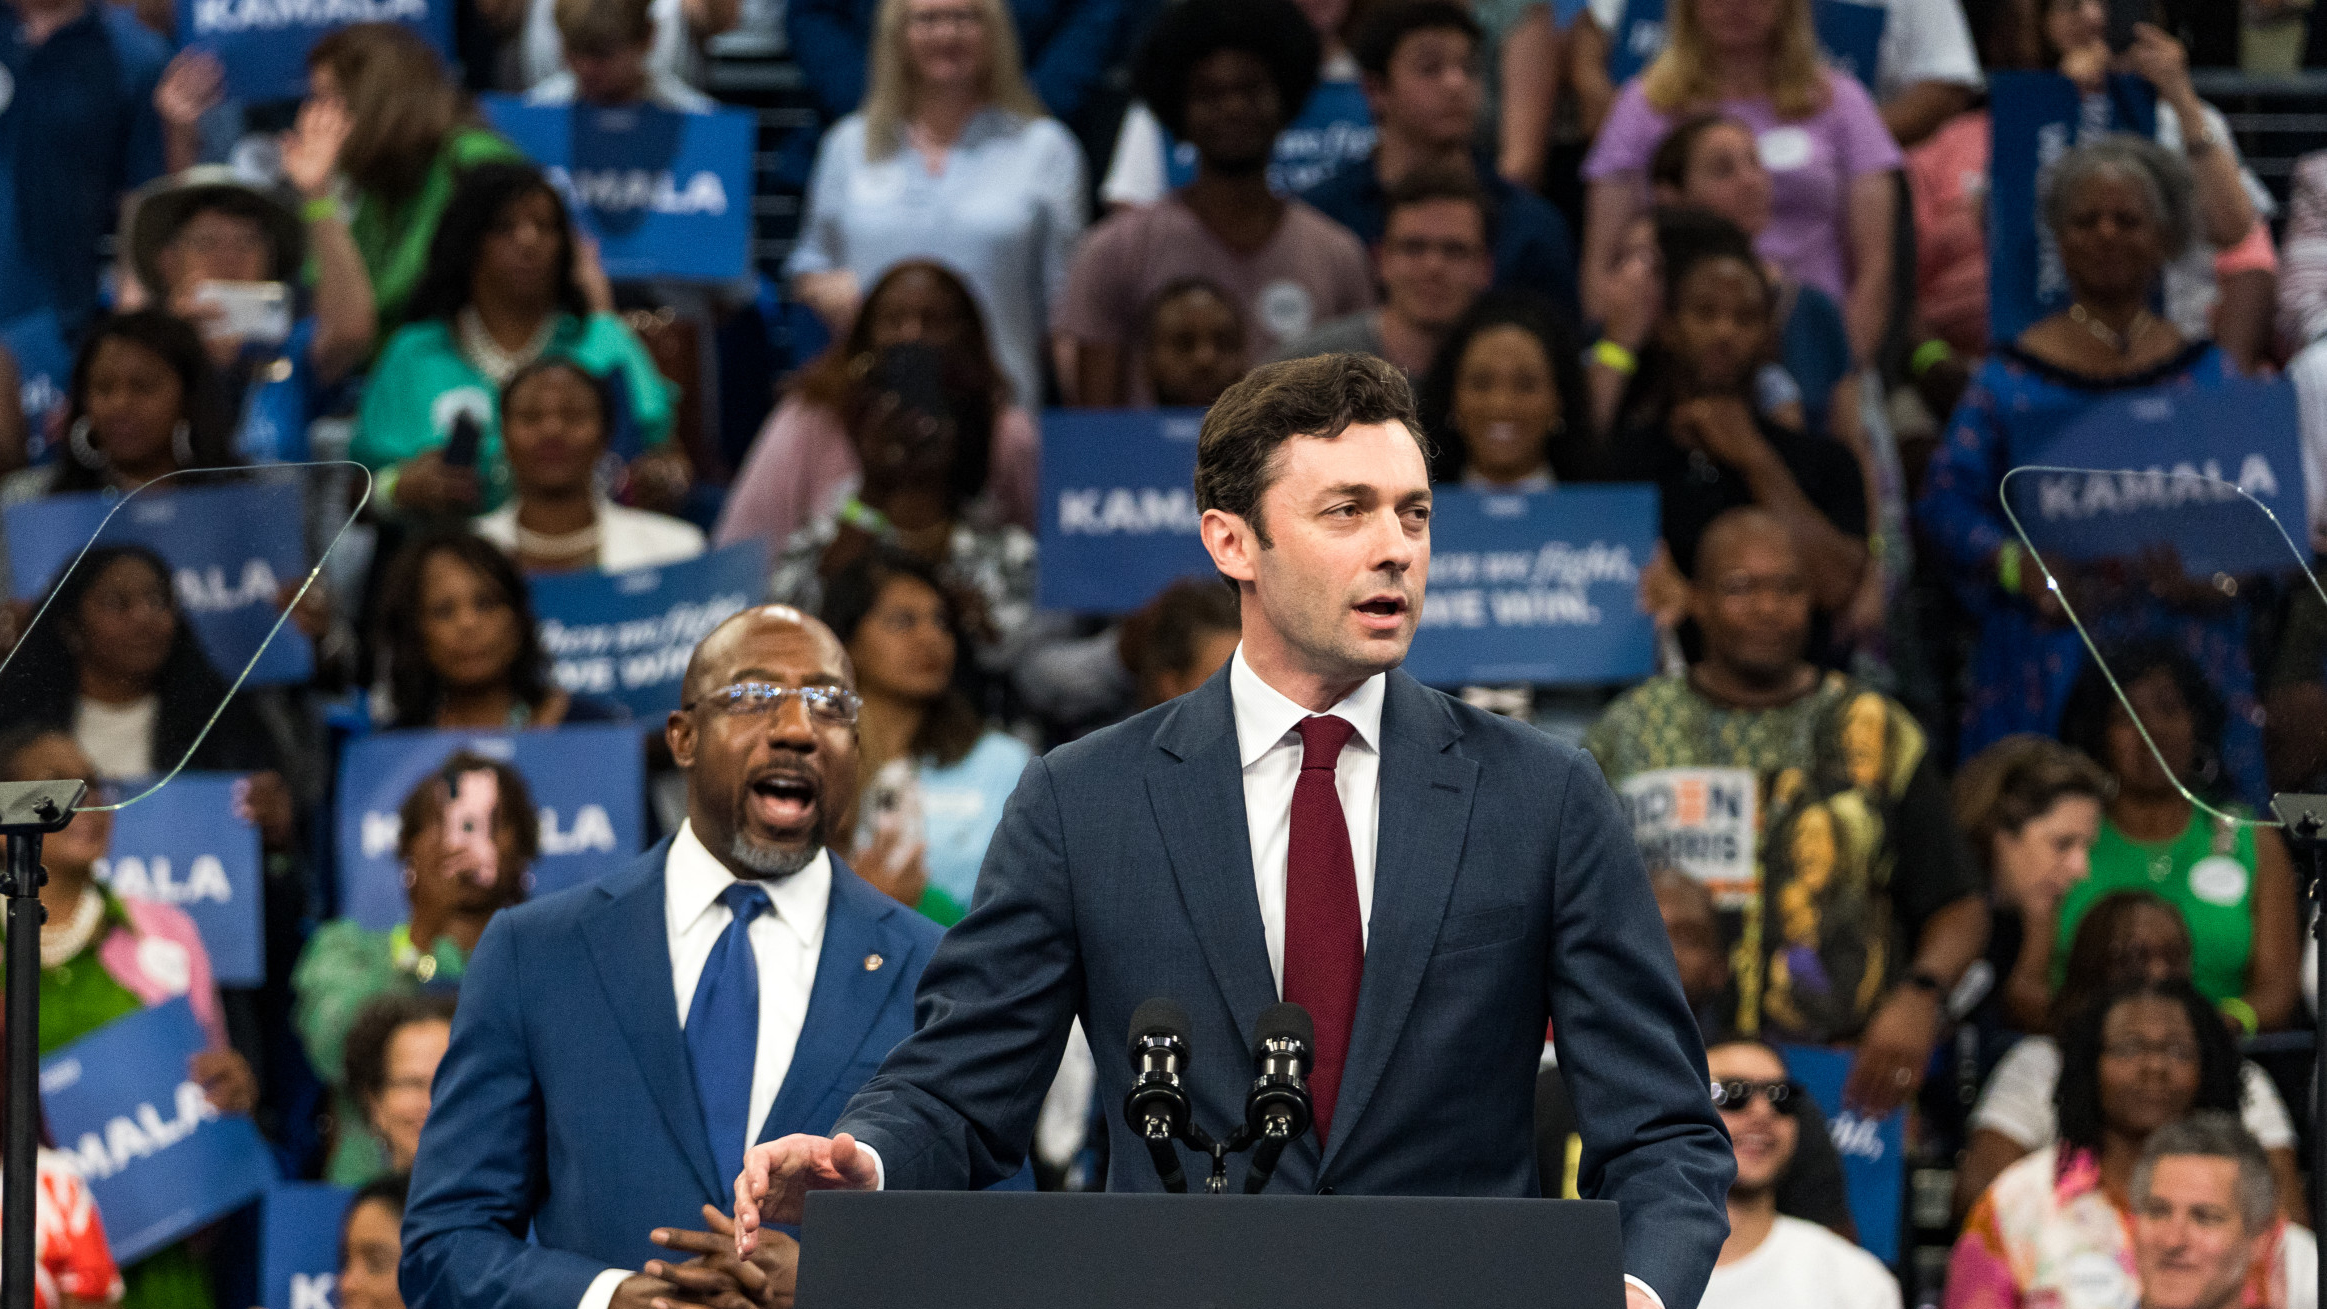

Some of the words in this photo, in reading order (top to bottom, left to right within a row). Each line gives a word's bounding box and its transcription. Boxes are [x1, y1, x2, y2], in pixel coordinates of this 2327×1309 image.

[1059, 486, 1201, 537] KAM
[2039, 455, 2279, 521] KAMALA
[92, 855, 233, 904] ALA
